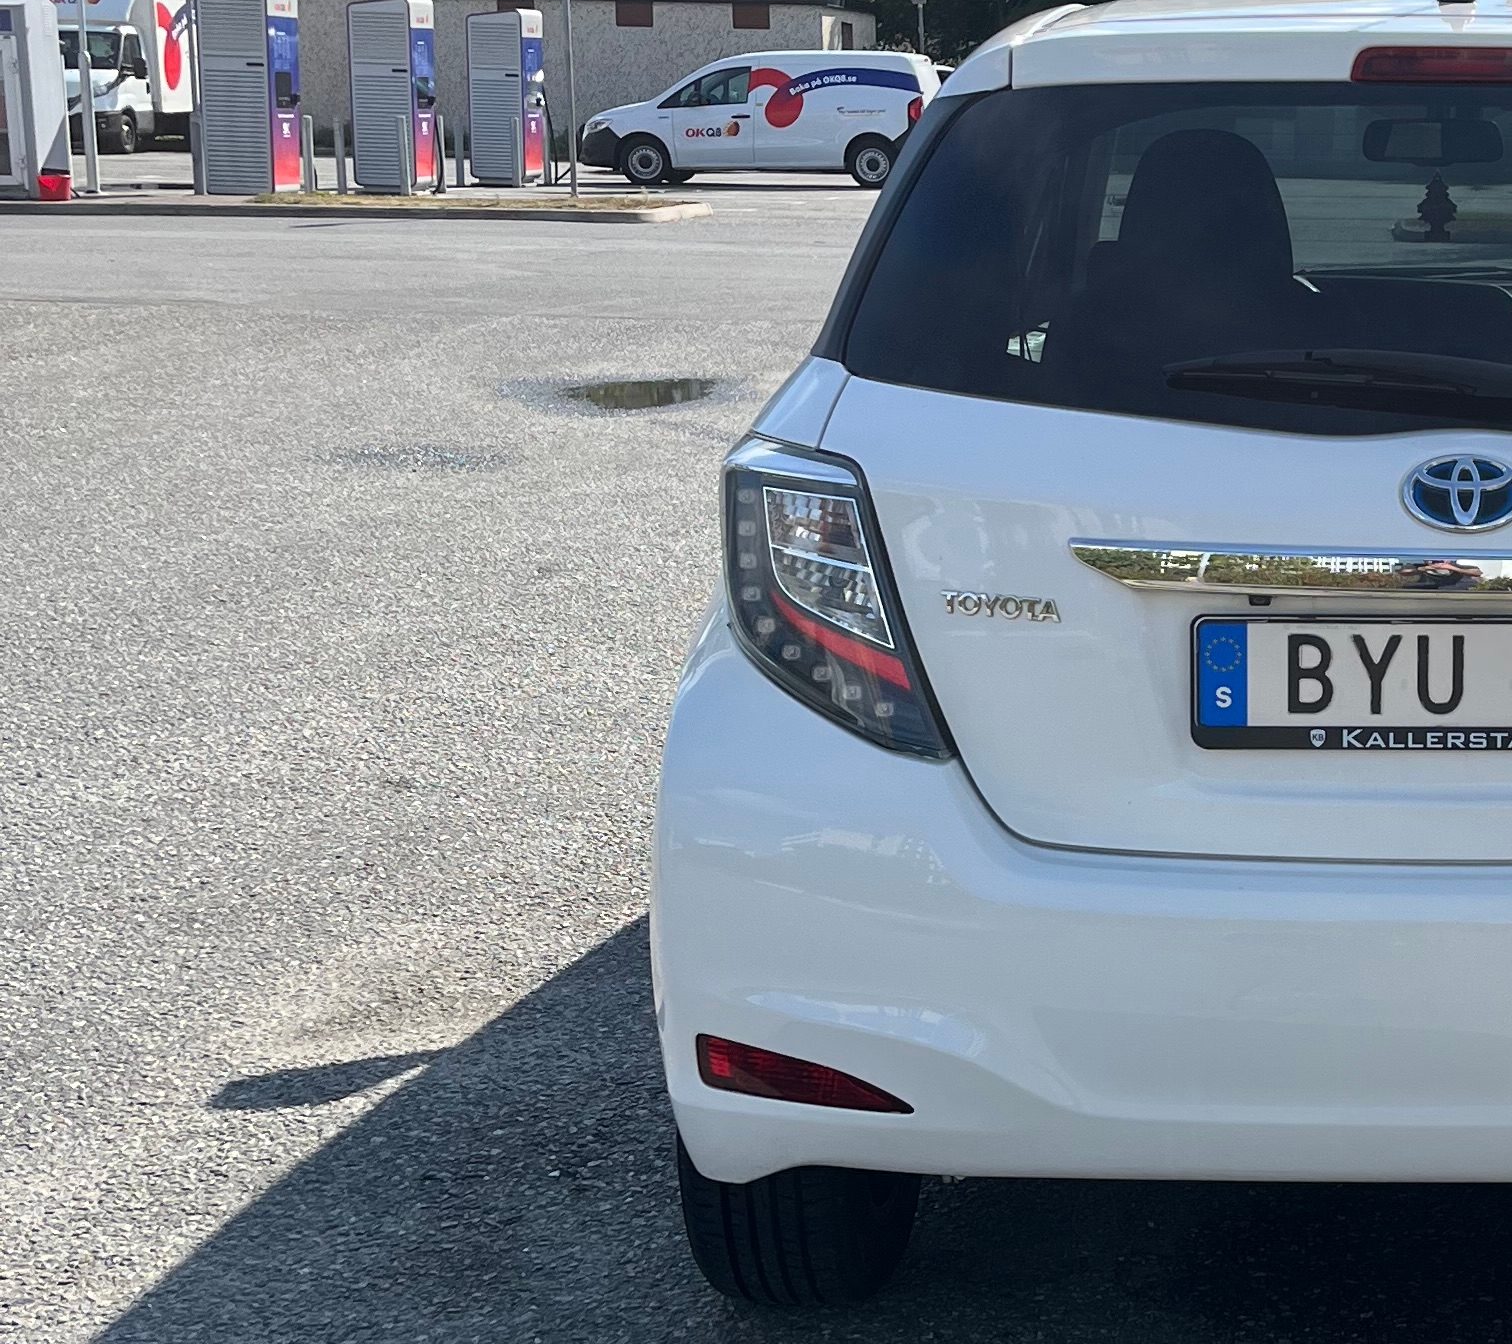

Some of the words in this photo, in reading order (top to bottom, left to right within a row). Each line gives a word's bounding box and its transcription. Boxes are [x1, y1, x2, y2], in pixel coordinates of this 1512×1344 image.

[941, 589, 1062, 624] TOYOTA
[1287, 633, 1465, 716] BYU
[1214, 686, 1233, 709] S
